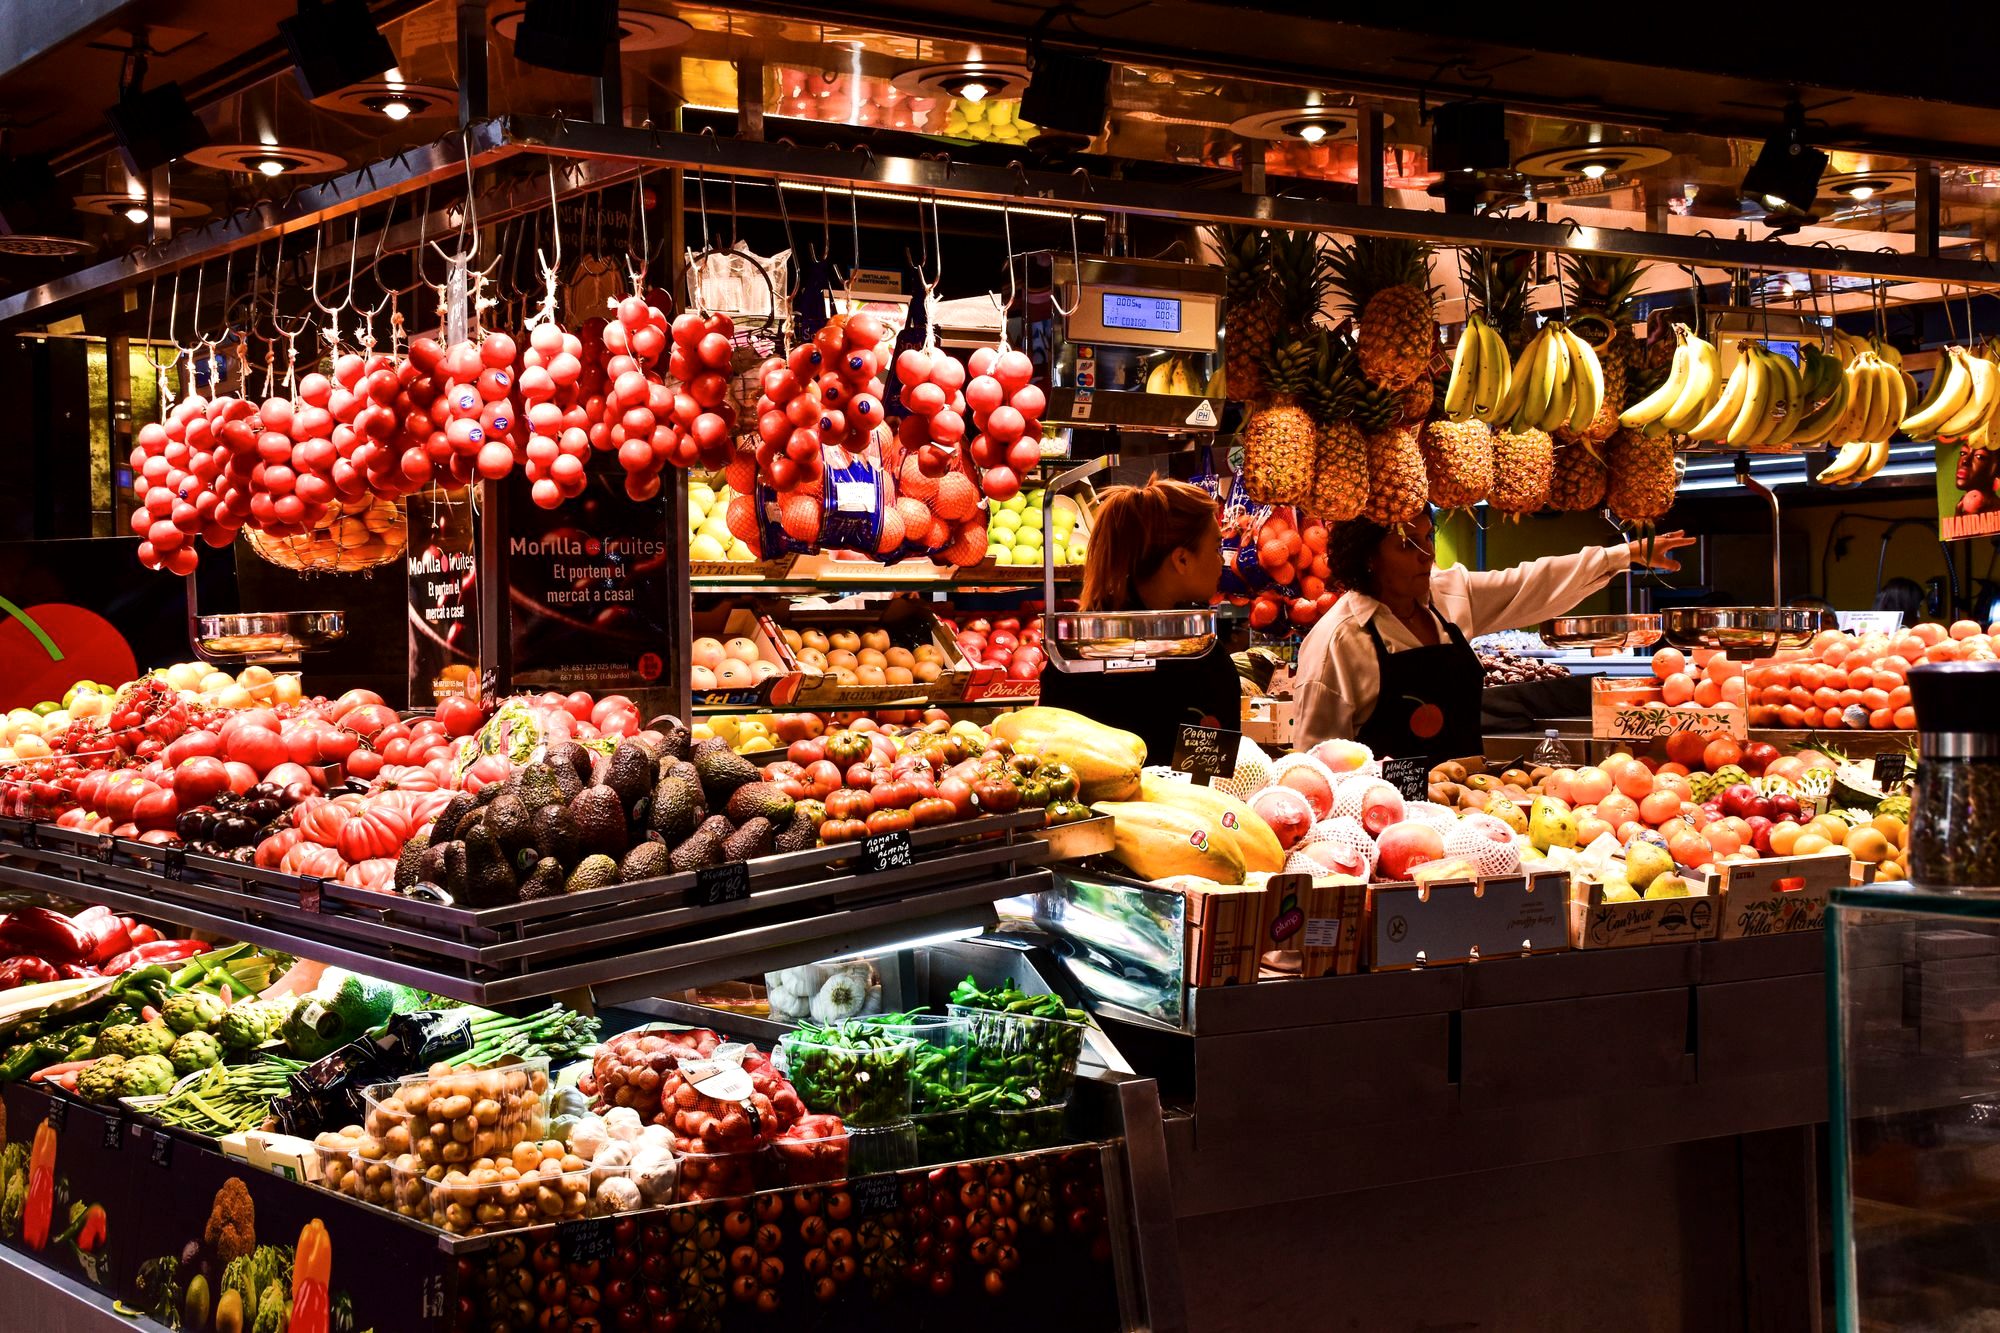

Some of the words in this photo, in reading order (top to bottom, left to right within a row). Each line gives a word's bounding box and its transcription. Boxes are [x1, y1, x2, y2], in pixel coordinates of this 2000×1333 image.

[510, 536, 582, 556] Morilla
[604, 536, 665, 555] fruites
[409, 556, 441, 576] Morilla
[448, 551, 475, 572] fruites
[553, 563, 566, 579] Et
[569, 564, 612, 583] portem
[614, 563, 626, 578] el
[547, 587, 591, 603] mercat
[593, 589, 600, 602] a
[604, 588, 635, 602] casa!
[983, 681, 1022, 698] Pink
[1614, 716, 1656, 736] Villa
[1274, 914, 1298, 936] plump
[1737, 911, 1773, 937] Villa
